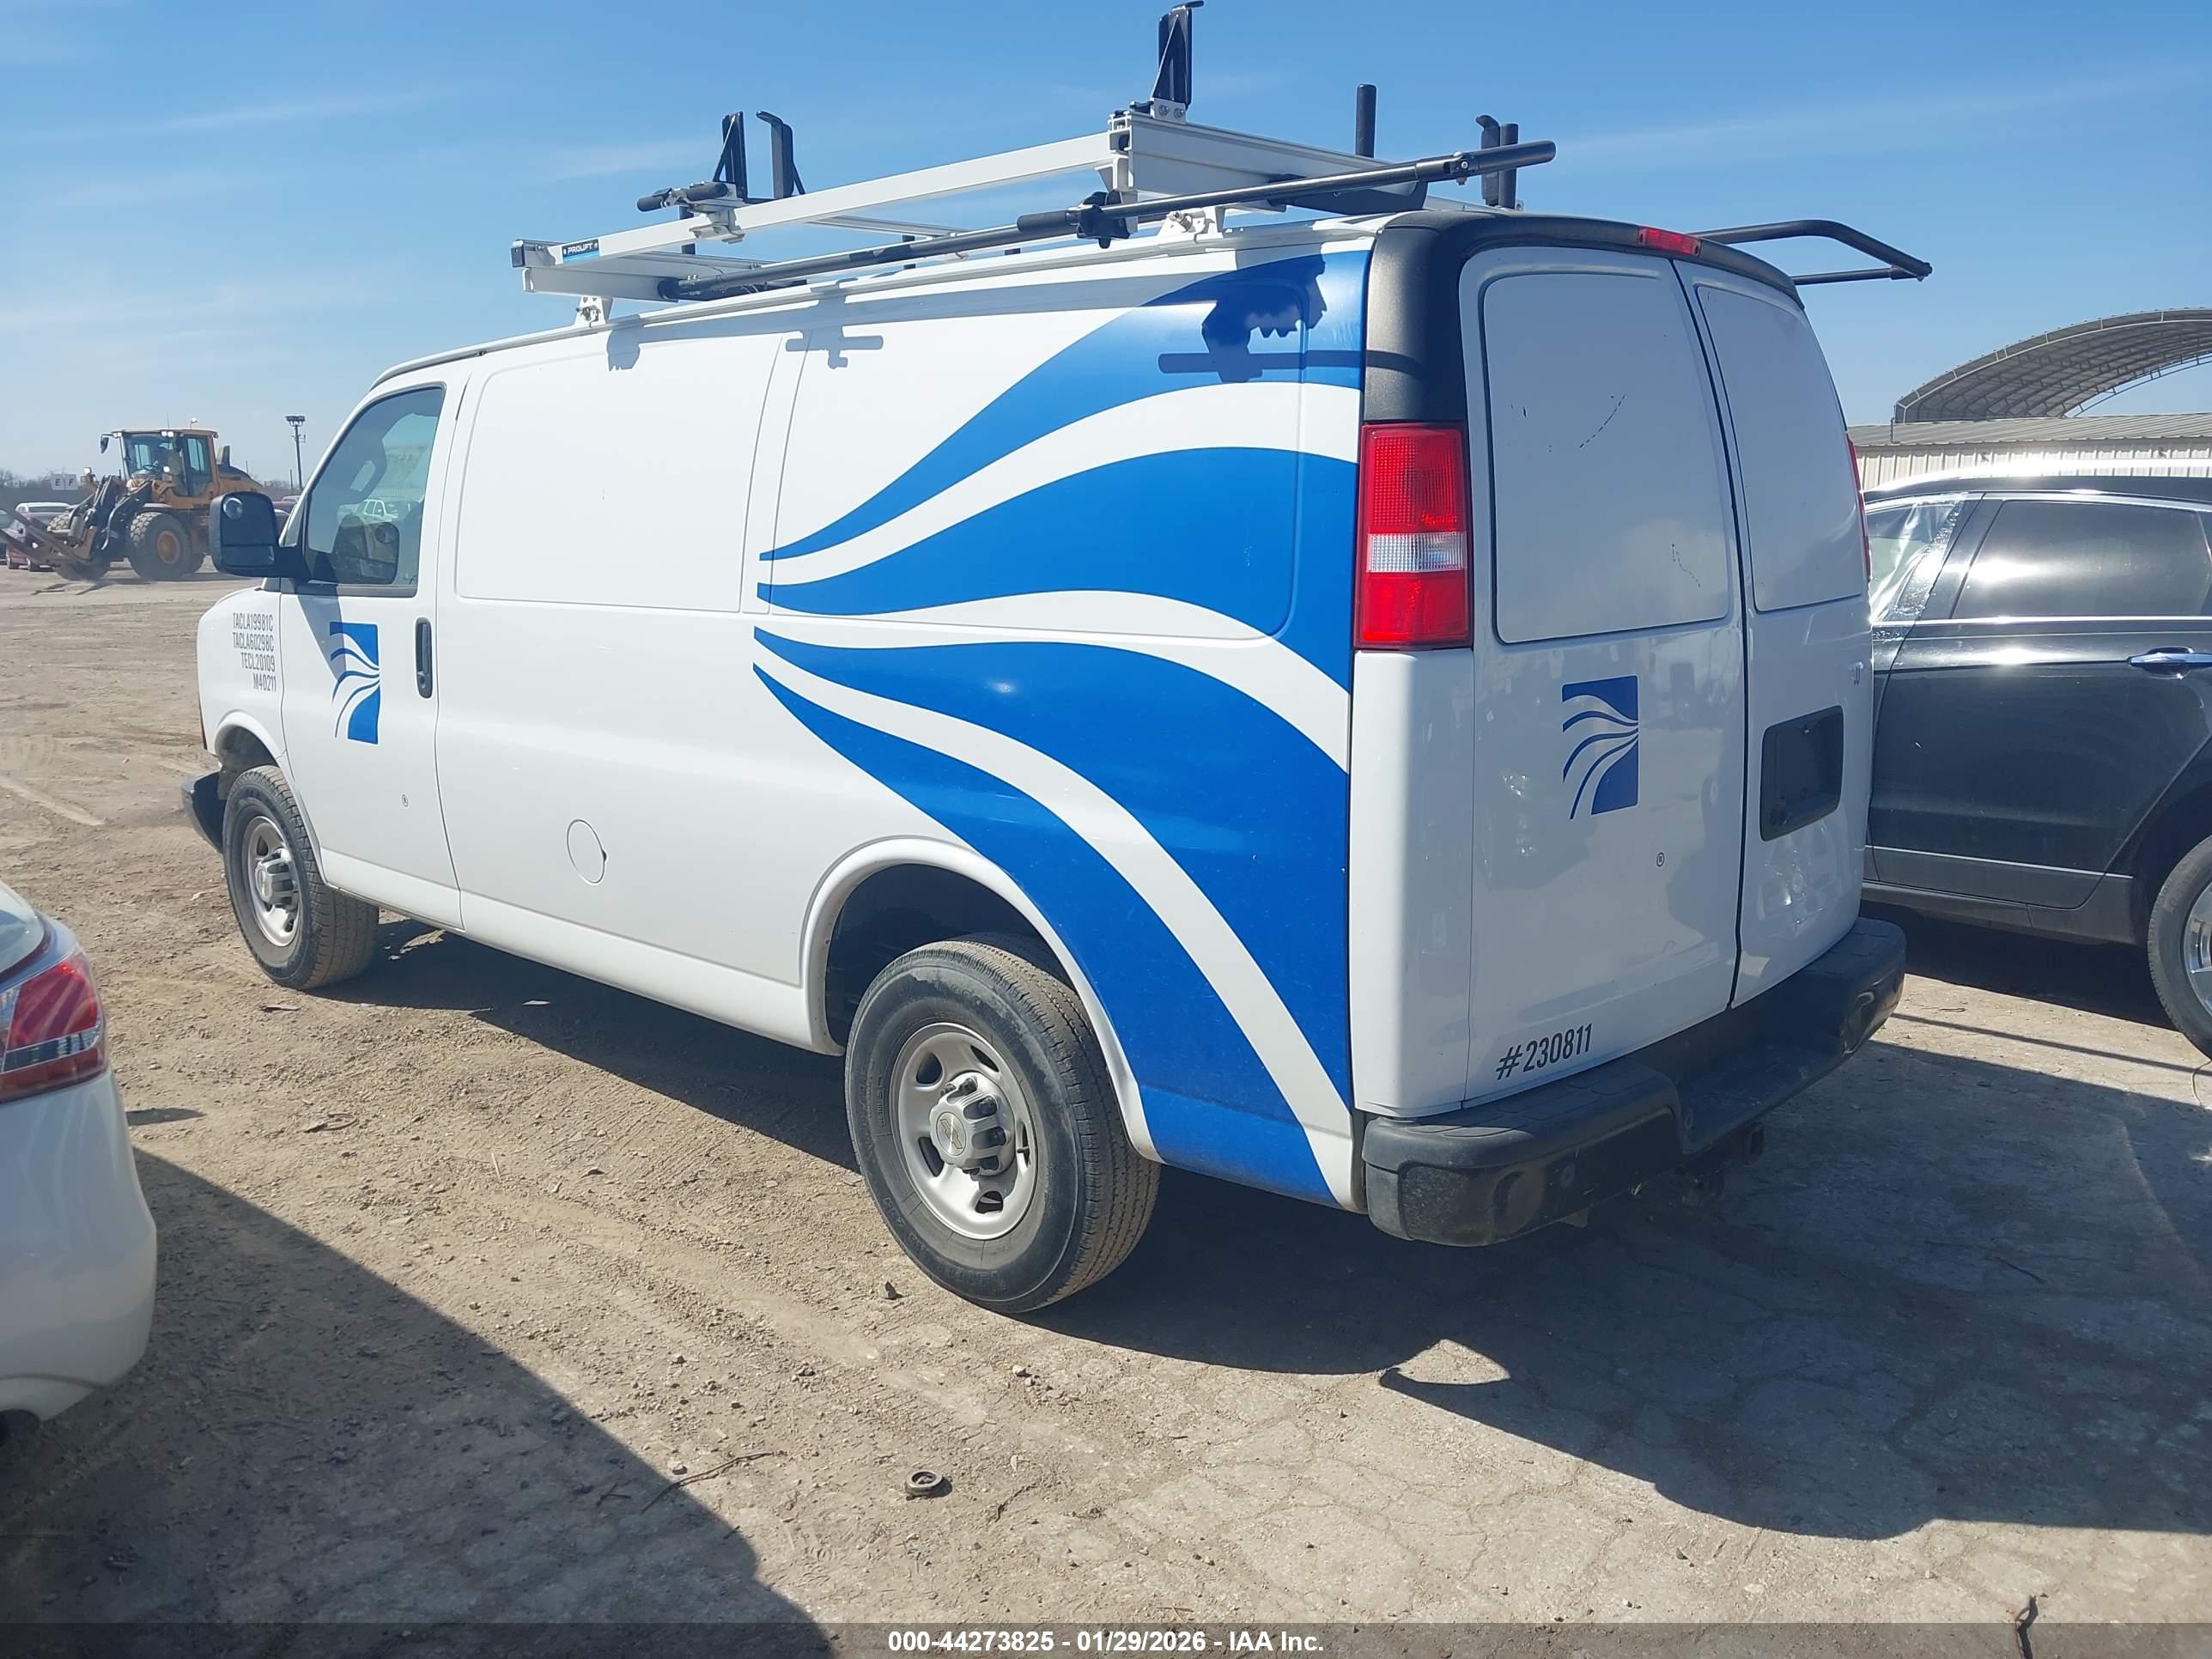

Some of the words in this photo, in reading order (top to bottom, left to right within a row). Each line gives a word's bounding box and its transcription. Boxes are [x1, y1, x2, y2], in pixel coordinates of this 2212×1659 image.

[233, 612, 273, 631] TACLA19981C
[233, 632, 275, 653] TACLA60298C
[240, 652, 276, 672] TECL20109
[252, 672, 276, 692] M40211
[1495, 1023, 1593, 1080] #230811
